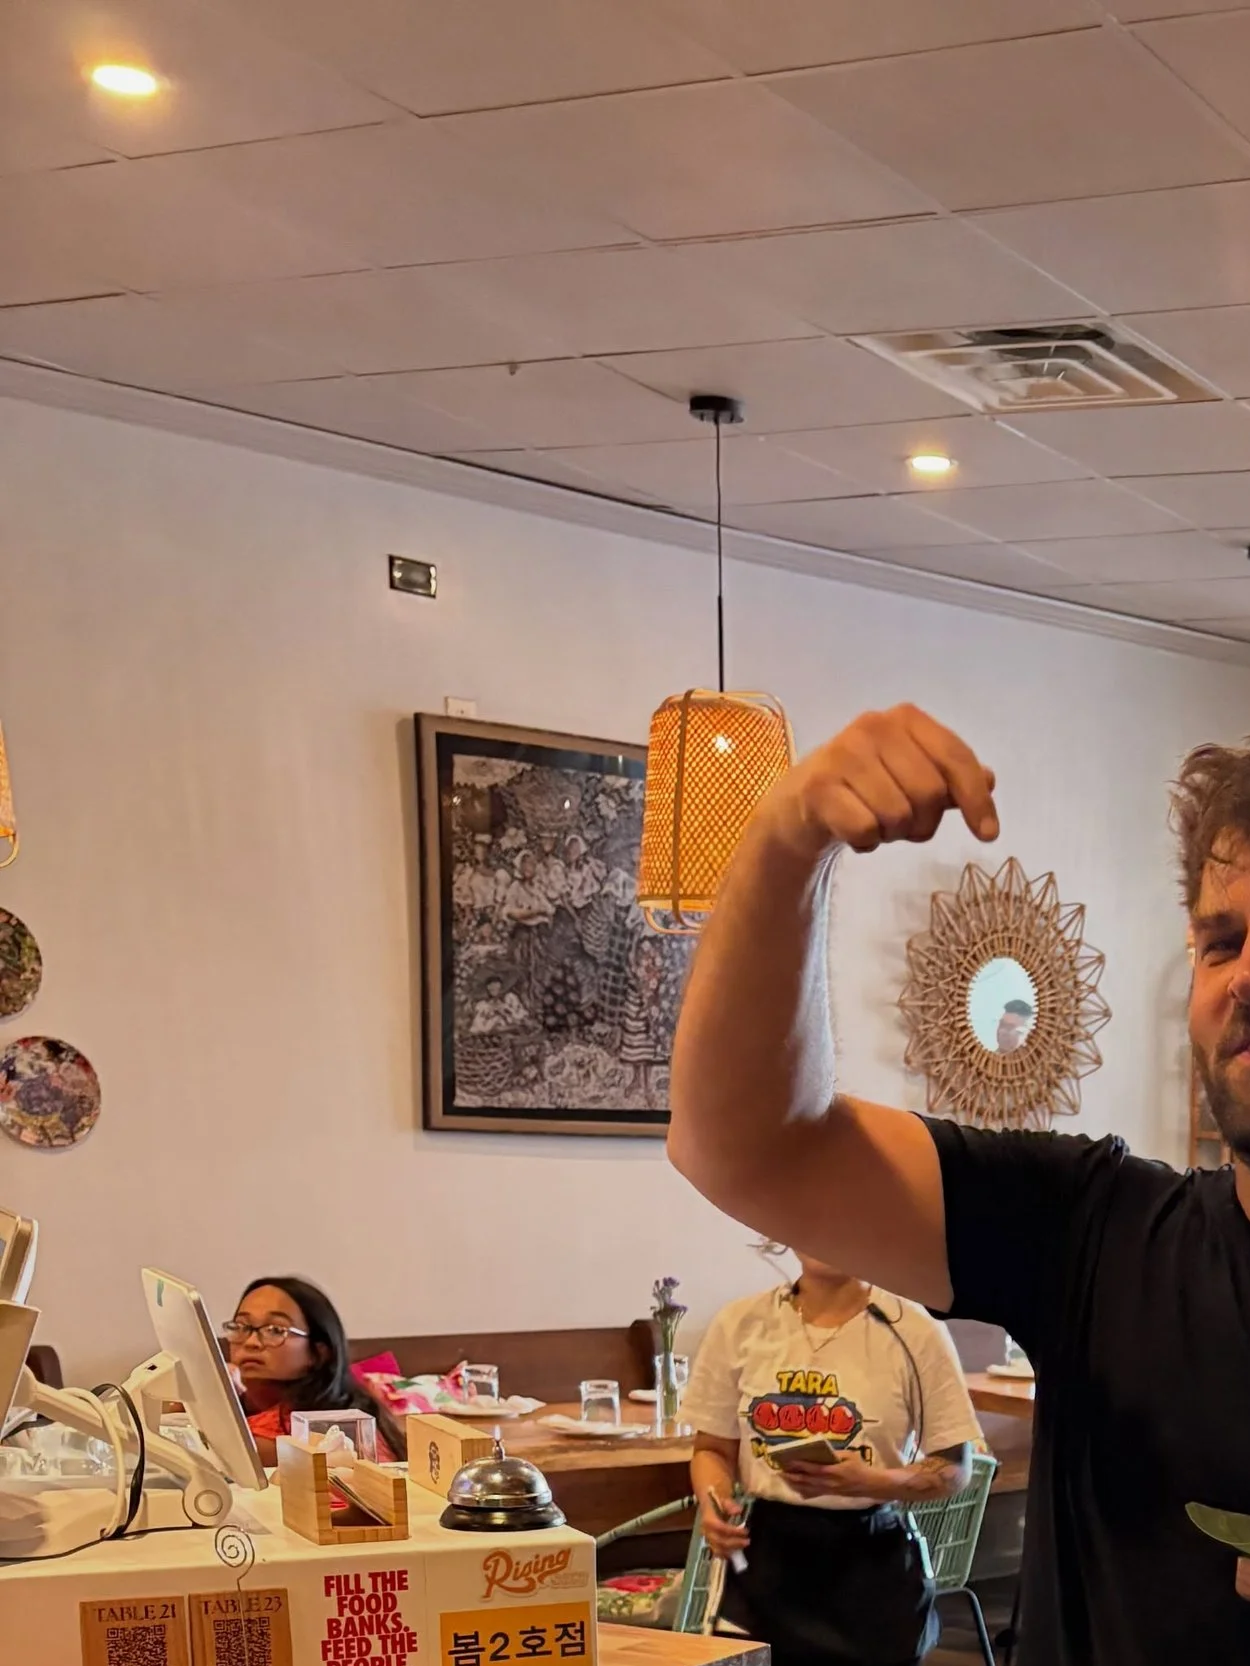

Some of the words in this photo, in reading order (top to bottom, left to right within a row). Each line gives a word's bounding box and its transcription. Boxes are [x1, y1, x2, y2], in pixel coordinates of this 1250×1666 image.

[776, 1370, 839, 1397] TARA
[324, 1573, 366, 1598] FILL
[368, 1569, 409, 1593] THE
[481, 1548, 571, 1599] Rising
[94, 1604, 156, 1623] TABLE
[161, 1604, 177, 1619] 21
[264, 1596, 283, 1613] 23
[337, 1591, 398, 1618] FOOD
[326, 1612, 411, 1640] BANKS.
[321, 1636, 373, 1662] FEED
[377, 1631, 419, 1656] THE
